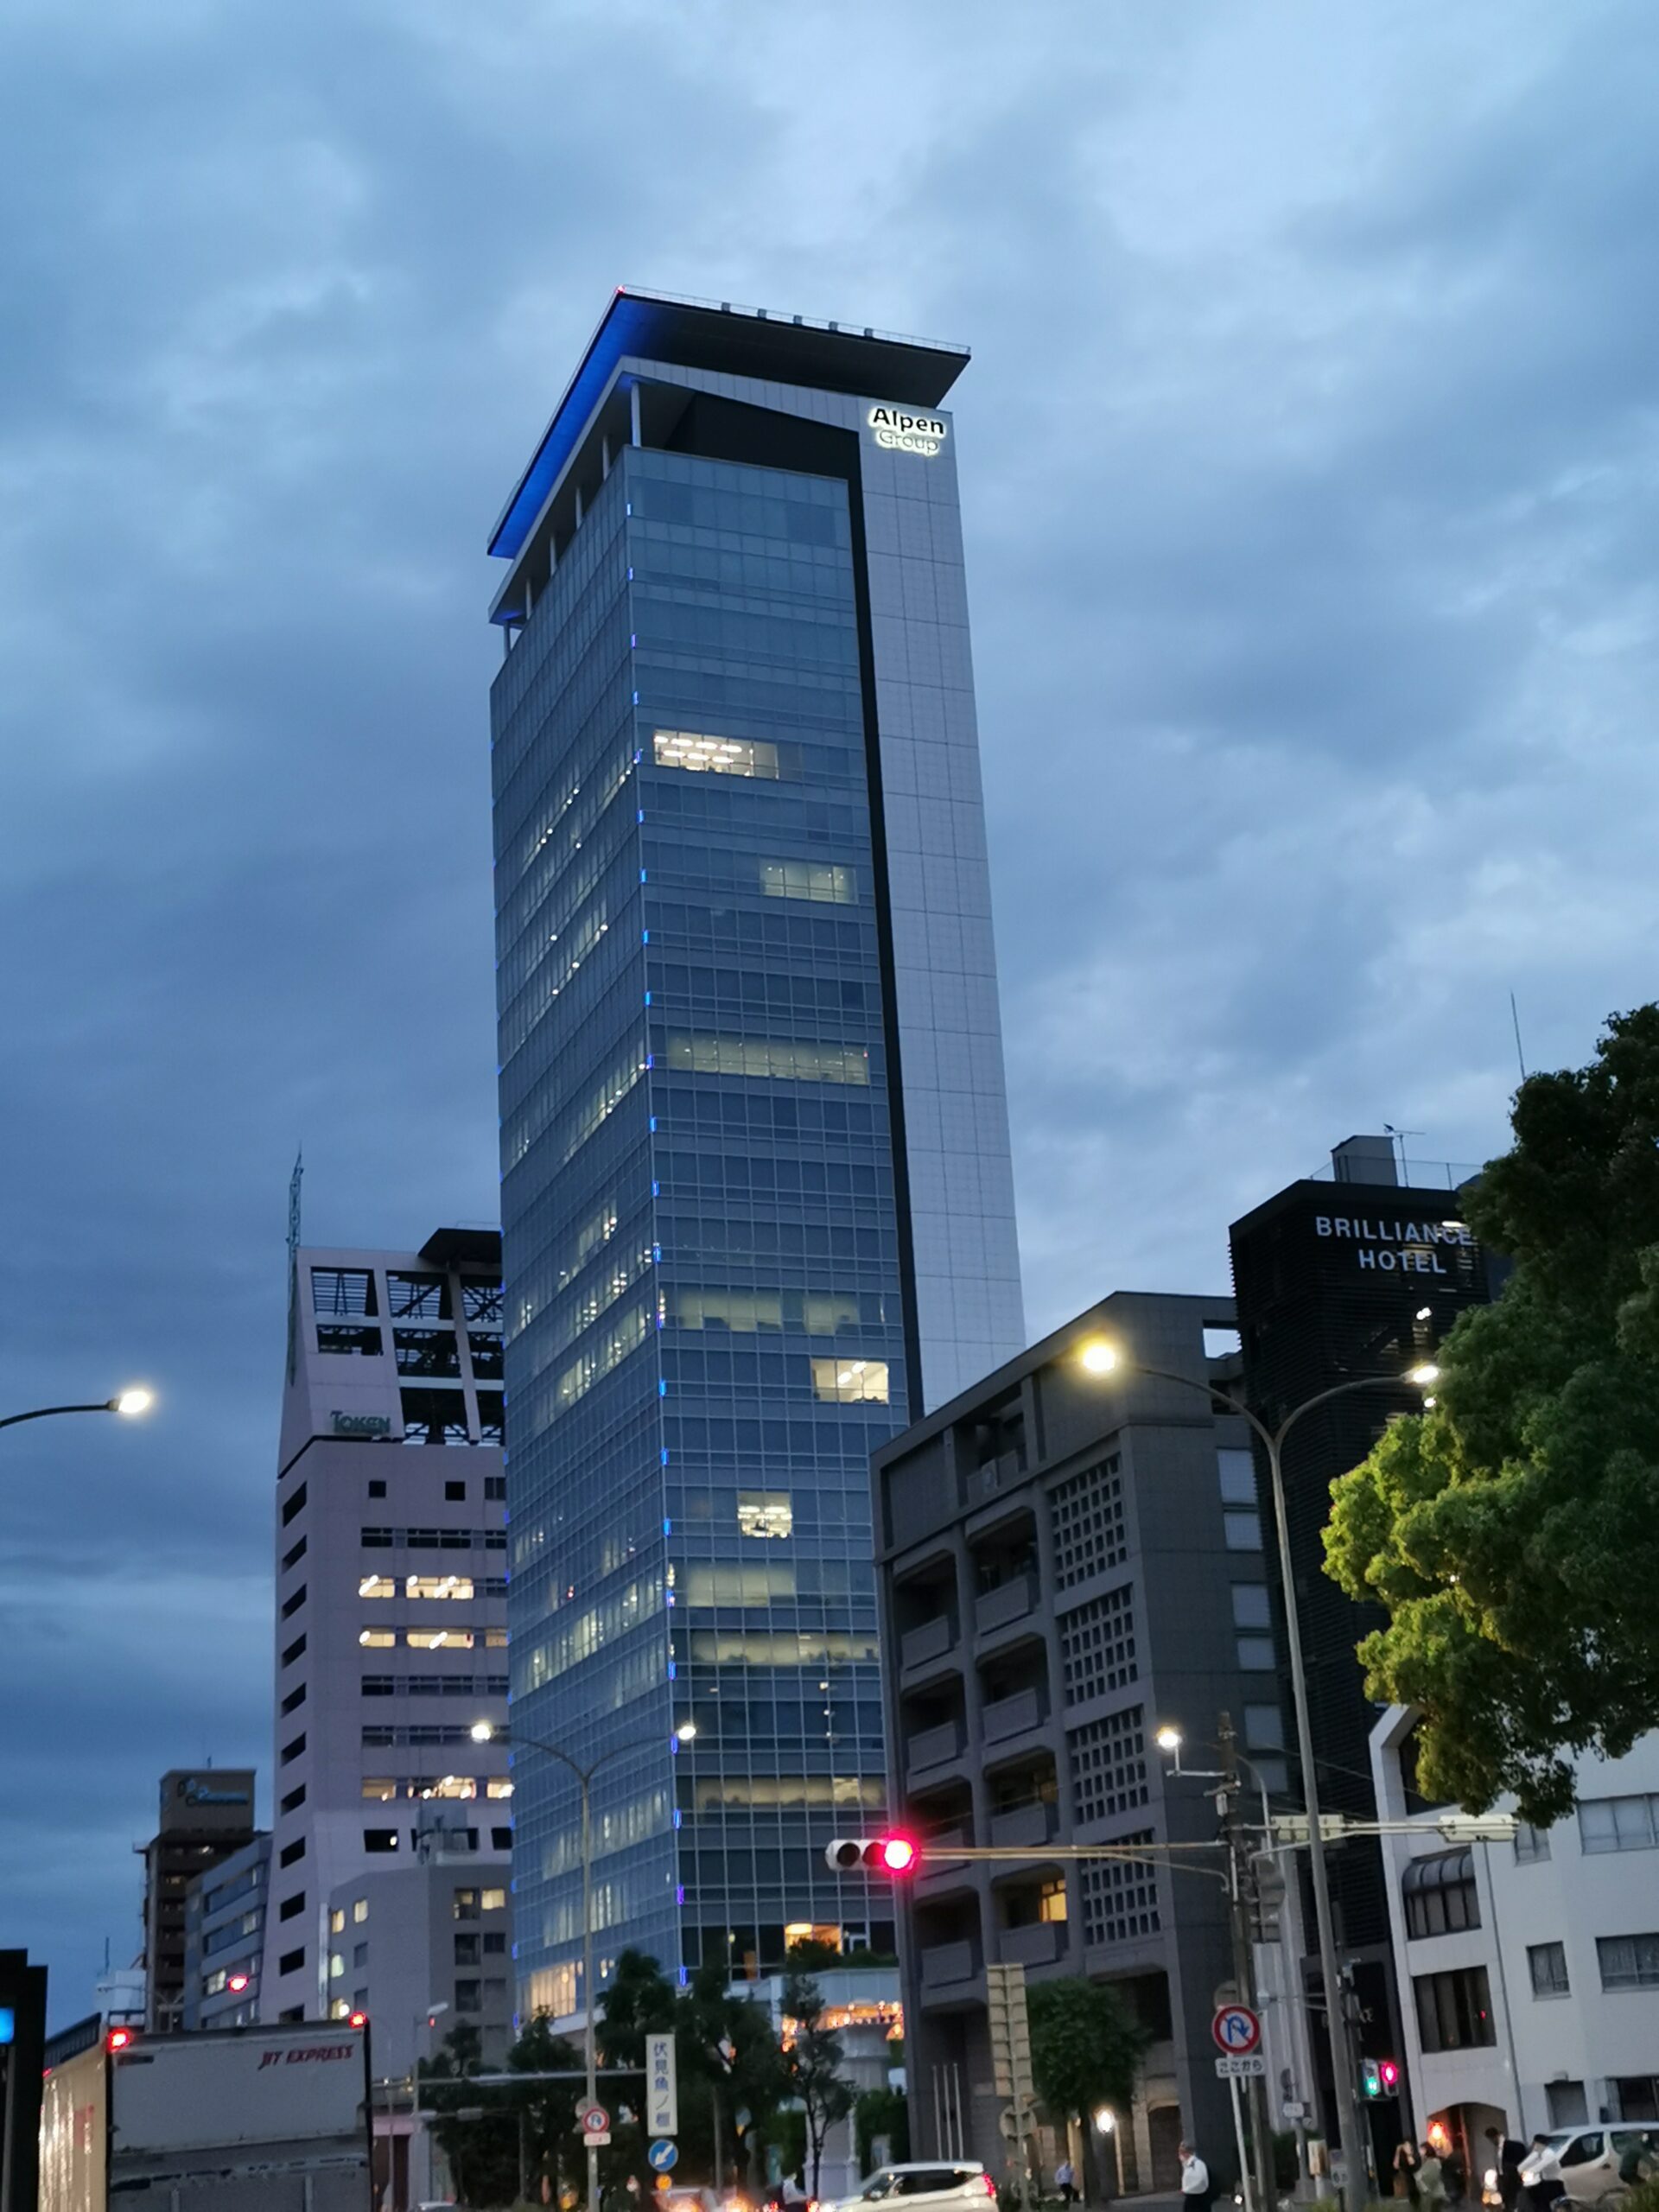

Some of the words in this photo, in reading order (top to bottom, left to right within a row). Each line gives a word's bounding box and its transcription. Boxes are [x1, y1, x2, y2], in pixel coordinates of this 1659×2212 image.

[874, 408, 944, 434] Alpen
[879, 429, 939, 454] Group
[1316, 1216, 1478, 1245] BRILLIANCE
[1358, 1249, 1447, 1274] HOTEL
[286, 2044, 354, 2065] EXPRESS
[1219, 2059, 1262, 2074] ここから
